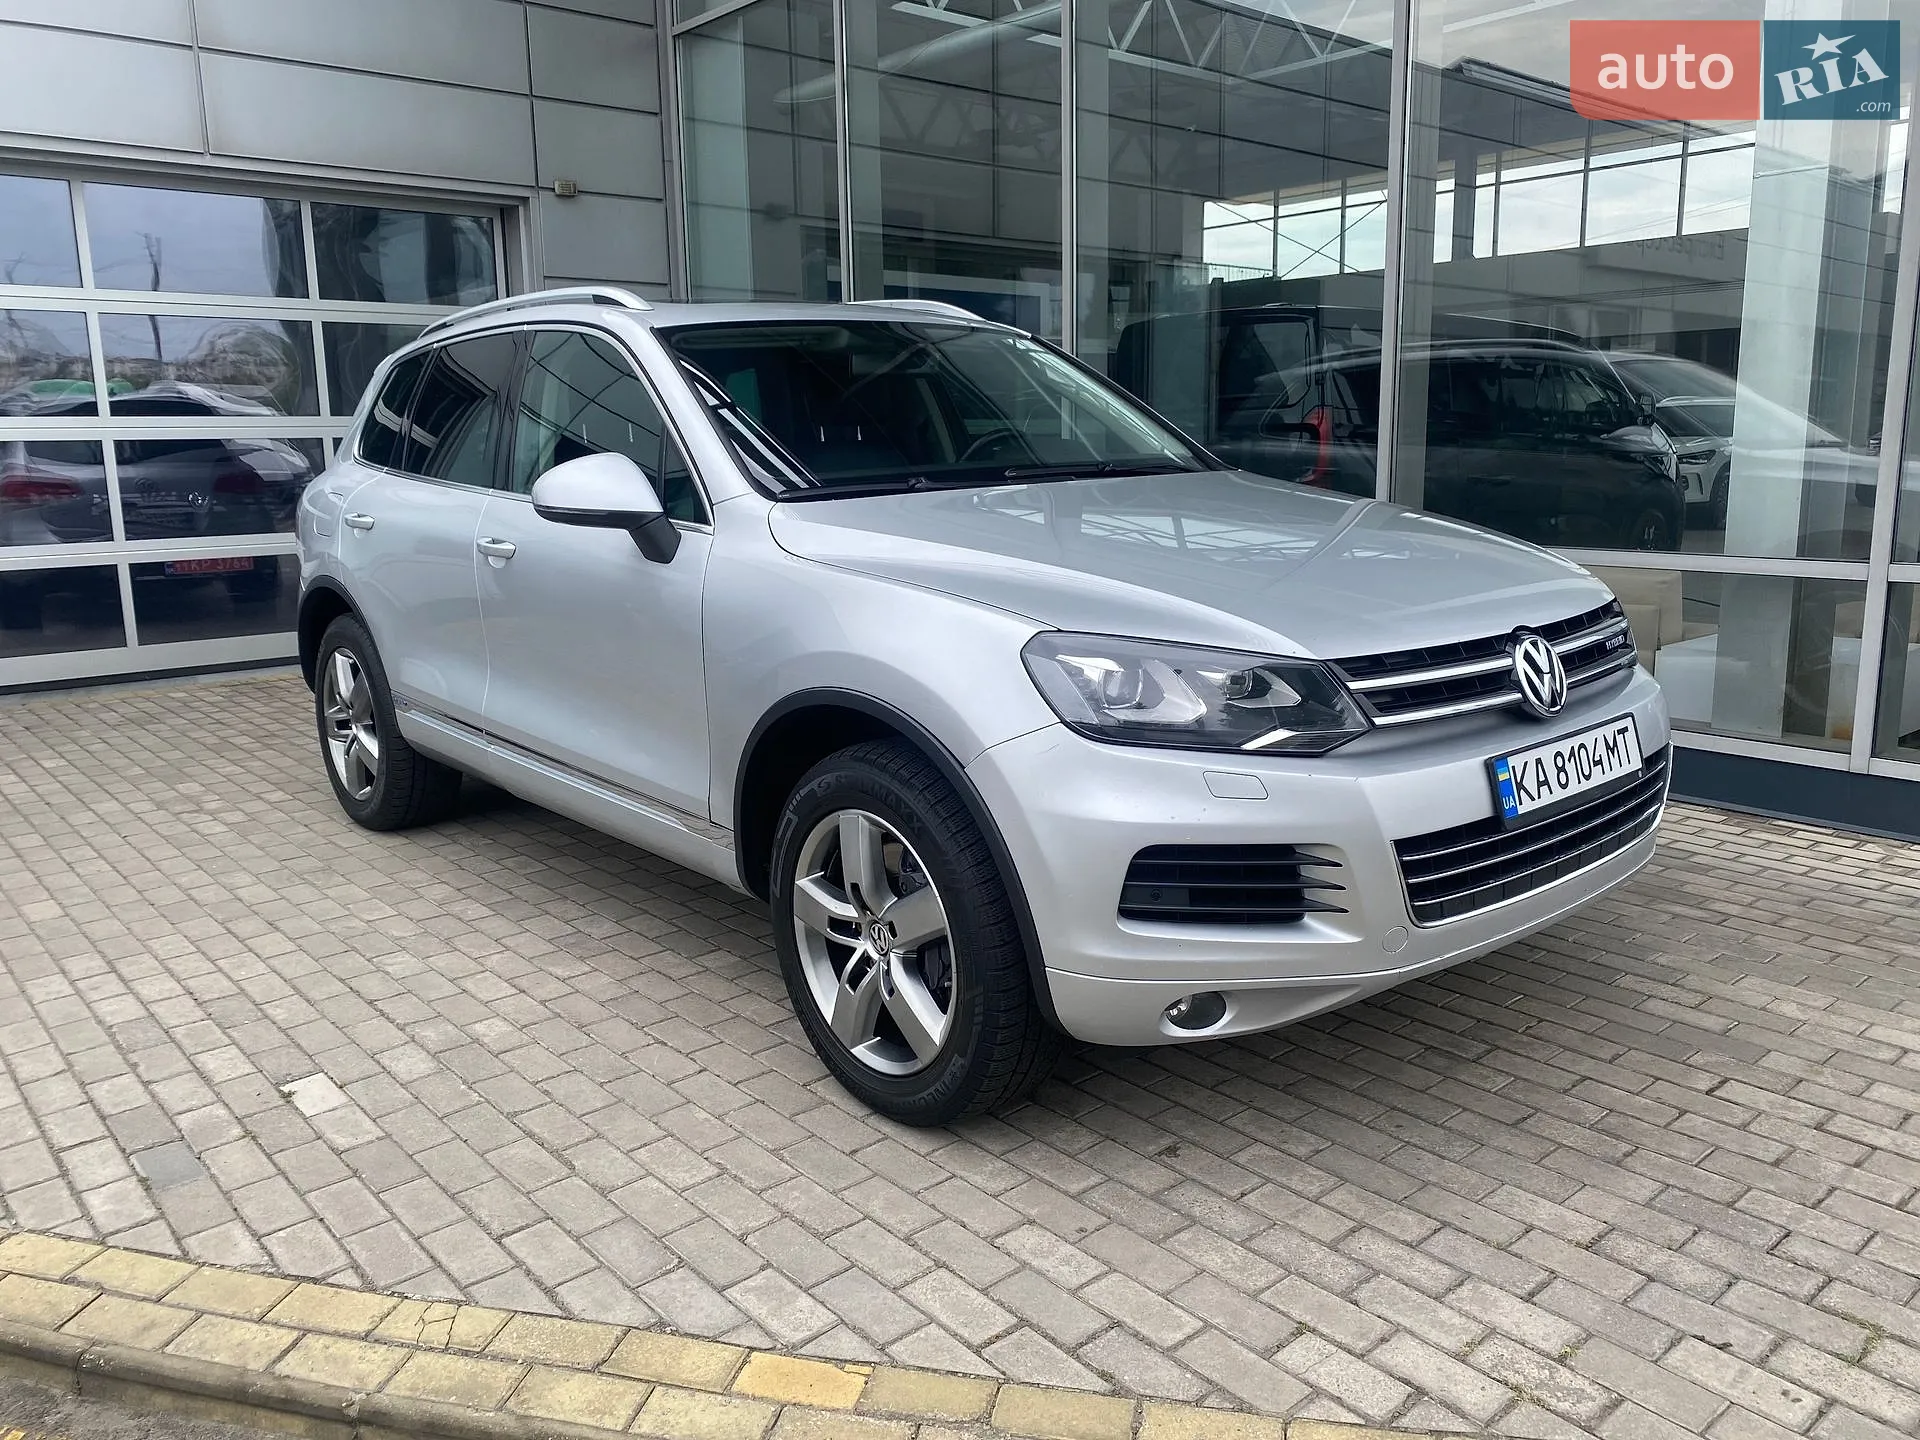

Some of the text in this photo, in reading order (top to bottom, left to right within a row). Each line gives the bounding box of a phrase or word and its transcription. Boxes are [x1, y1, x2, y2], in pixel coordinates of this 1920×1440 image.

[1511, 726, 1630, 805] KA 8104 MT
[1504, 795, 1516, 809] UA
